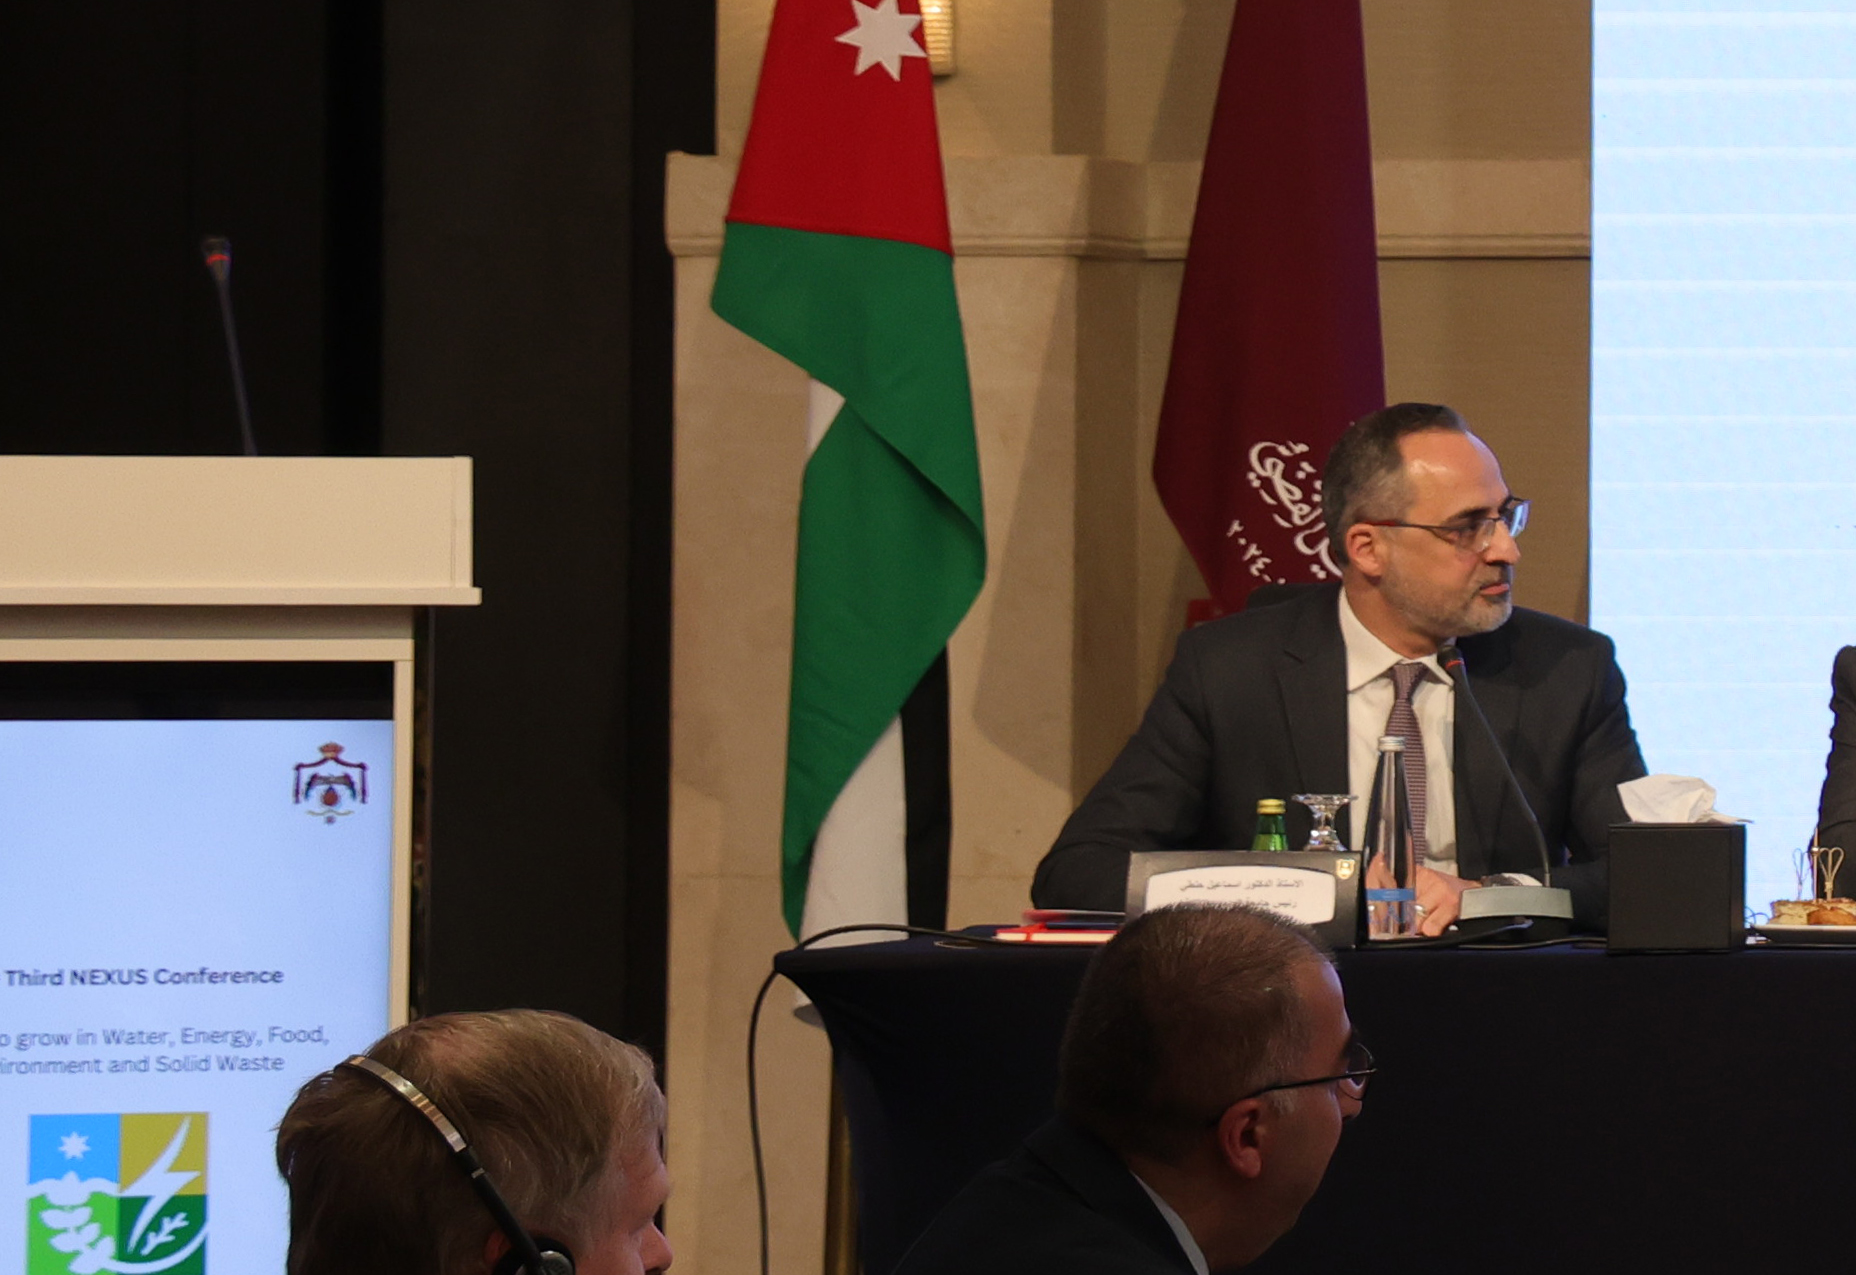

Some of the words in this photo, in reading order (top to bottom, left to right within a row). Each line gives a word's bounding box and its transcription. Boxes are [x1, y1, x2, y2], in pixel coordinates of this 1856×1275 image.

[4, 968, 65, 986] Third
[69, 968, 149, 986] NEXUS
[153, 967, 285, 985] Conference
[15, 1032, 72, 1051] grow
[76, 1028, 97, 1045] in
[102, 1028, 176, 1048] Water,
[180, 1026, 263, 1049] Energy,
[268, 1025, 330, 1046] Food,
[107, 1055, 149, 1073] and
[155, 1054, 212, 1072] Solid
[217, 1054, 286, 1072] Waste
